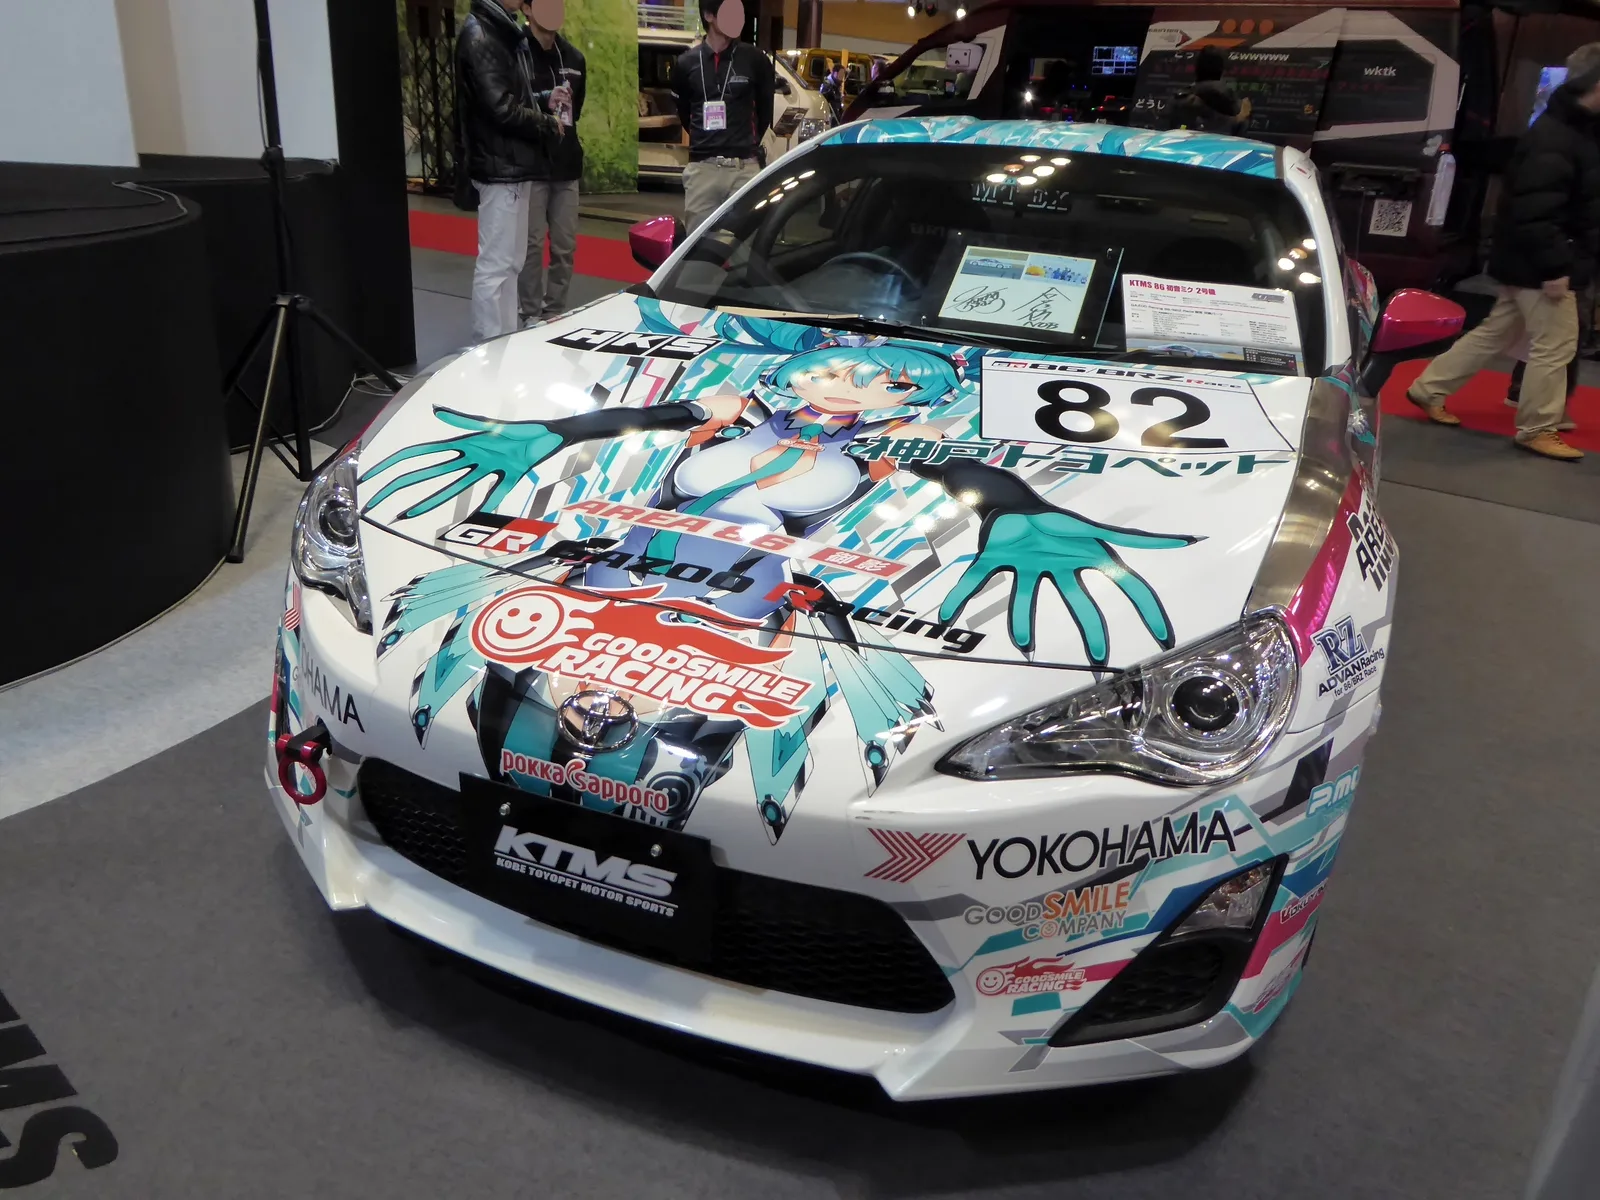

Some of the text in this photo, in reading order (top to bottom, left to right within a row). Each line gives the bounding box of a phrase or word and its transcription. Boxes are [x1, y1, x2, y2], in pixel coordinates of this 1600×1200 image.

[1363, 65, 1397, 77] wktk
[1129, 279, 1152, 289] KTMS
[1154, 282, 1165, 291] 86
[560, 328, 715, 354] HKS
[1029, 363, 1185, 382] 86/BRZ
[1186, 378, 1241, 388] Race
[1034, 379, 1229, 449] 82
[864, 436, 1290, 478] 神戸トヨペット
[563, 500, 713, 533] AREA
[444, 523, 539, 553] GR
[1313, 615, 1367, 675] RZ
[544, 646, 737, 710] RACING
[582, 632, 807, 700] GOODSMILE
[494, 824, 678, 897] KTMS
[966, 810, 1236, 880] YOKOHAMA
[496, 857, 675, 917] KOBE TOYOPET MOTOR SPORTS
[1023, 911, 1126, 939] COMPANY
[1008, 980, 1066, 994] RACING
[1014, 971, 1083, 984] GOODSMILE
